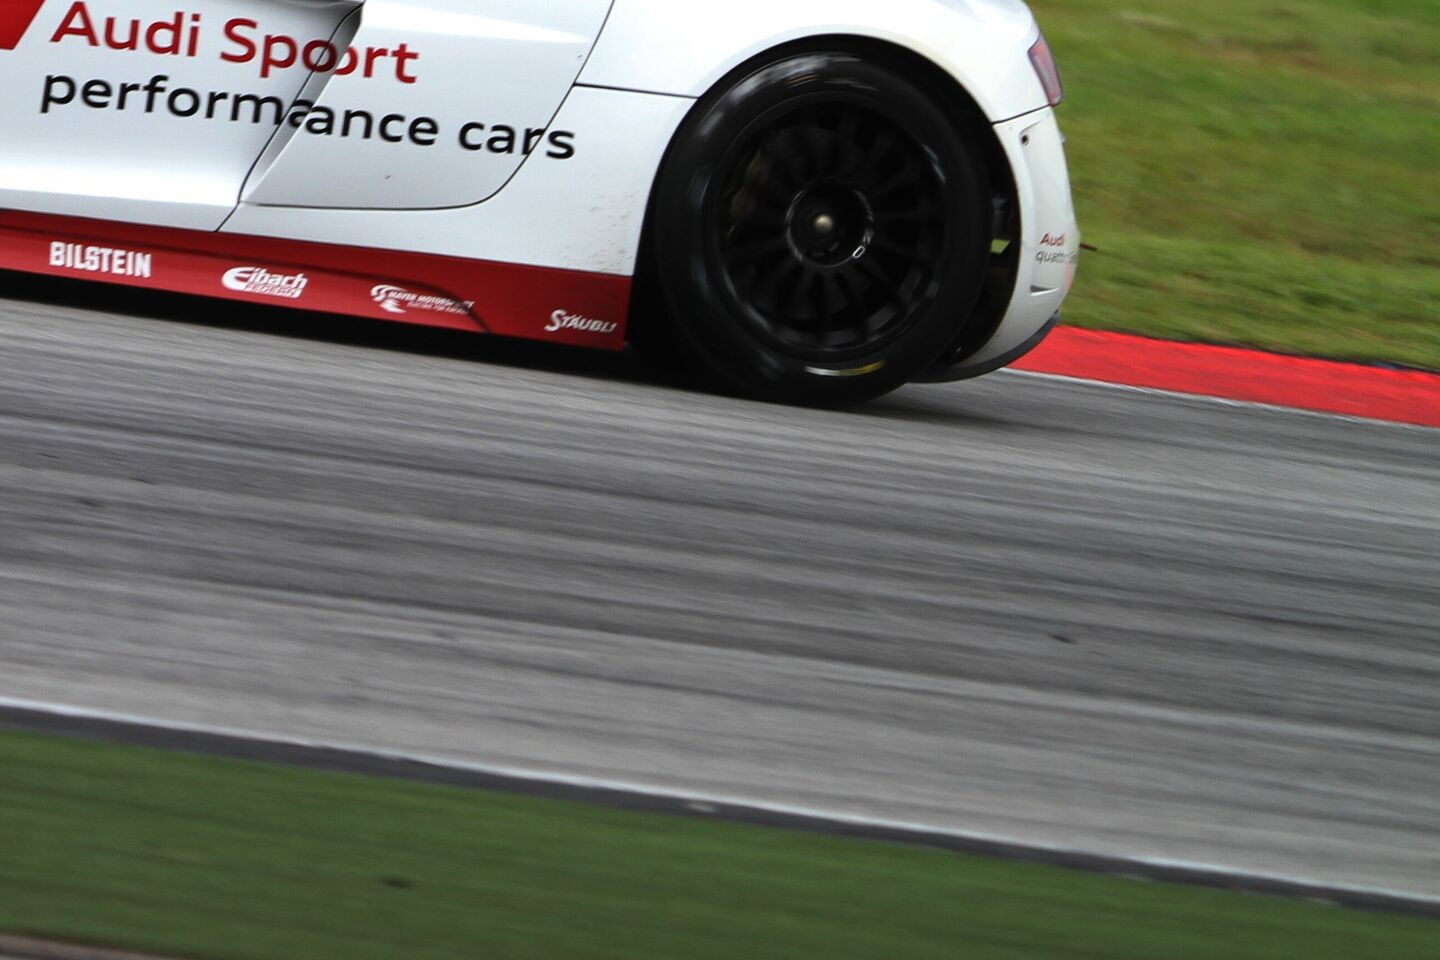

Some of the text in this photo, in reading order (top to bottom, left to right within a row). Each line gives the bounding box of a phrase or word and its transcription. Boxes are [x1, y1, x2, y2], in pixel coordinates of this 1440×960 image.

[49, 0, 421, 85] Audi Sport
[39, 73, 576, 160] performance cars
[48, 241, 153, 279] BILSTEIN
[220, 266, 309, 291] Eibach
